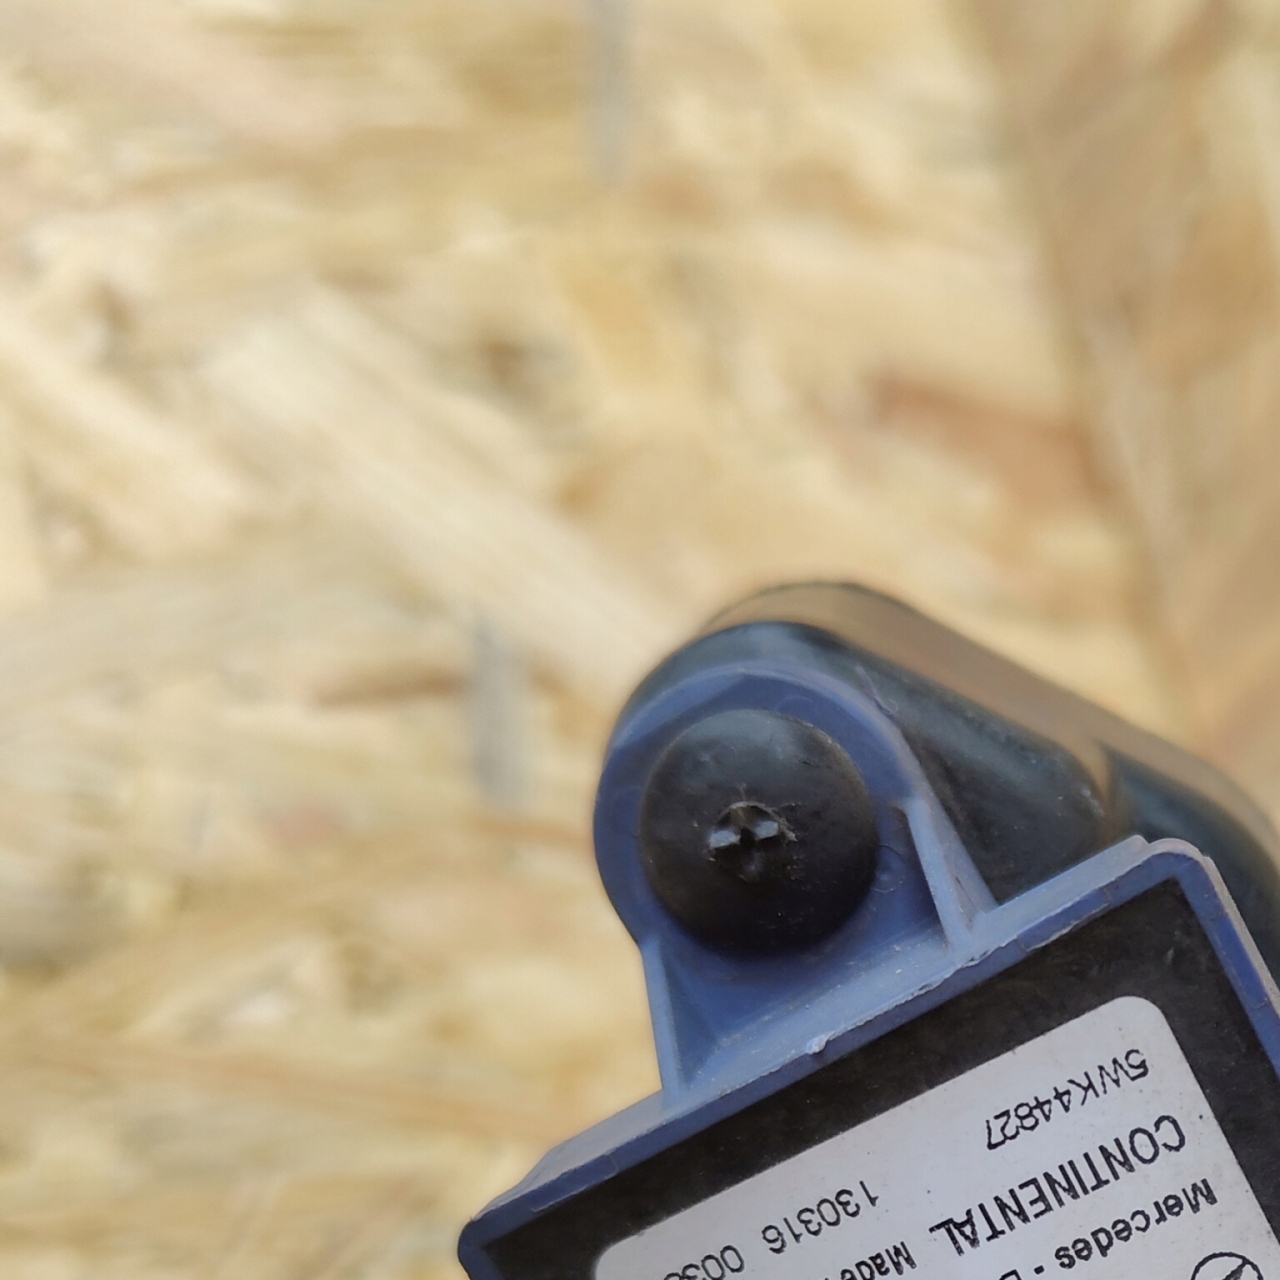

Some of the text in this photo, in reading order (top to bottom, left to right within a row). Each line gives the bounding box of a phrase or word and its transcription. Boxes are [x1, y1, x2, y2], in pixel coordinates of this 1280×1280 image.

[985, 1048, 1150, 1151] 5WK44827
[761, 1180, 880, 1255] 130316
[928, 1114, 1186, 1257] CONTINENTAL
[1054, 1177, 1218, 1270] Mercedes
[1033, 1264, 1045, 1276] -
